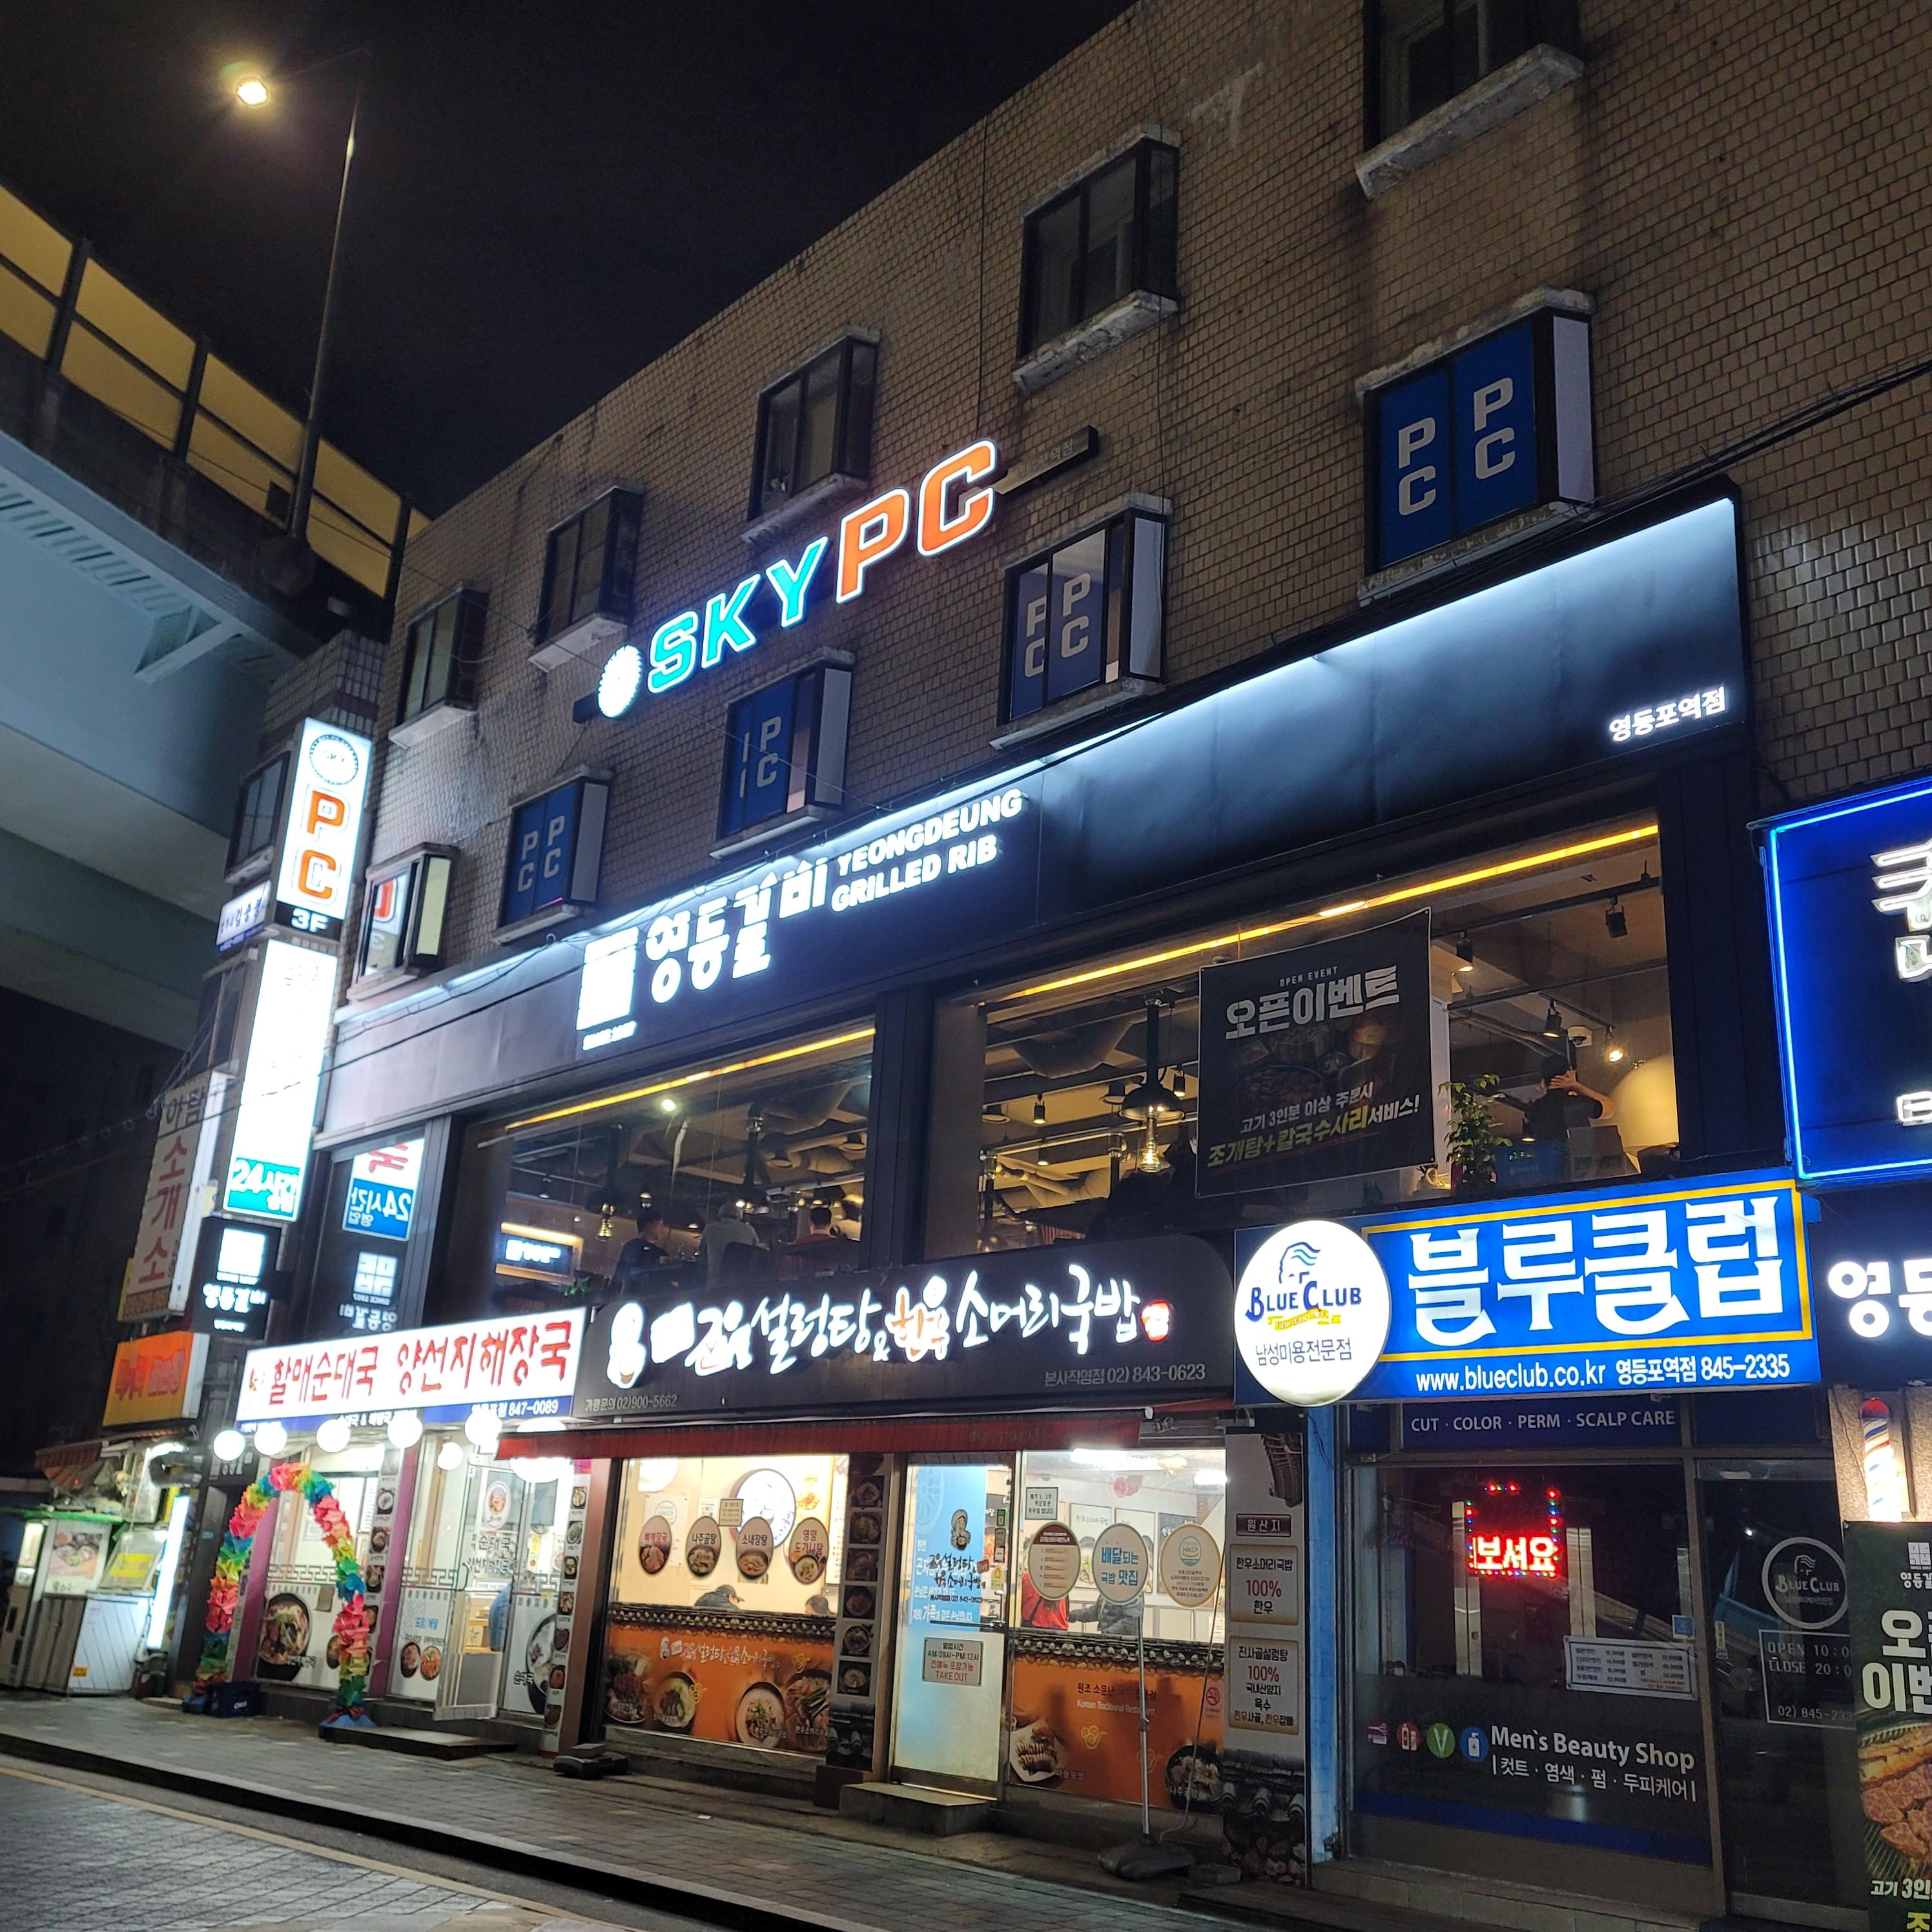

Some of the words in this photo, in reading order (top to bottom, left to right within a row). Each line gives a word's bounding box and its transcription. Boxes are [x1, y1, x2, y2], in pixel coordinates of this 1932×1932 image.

[1474, 377, 1516, 480] PC
[1398, 416, 1436, 516] PC
[1061, 572, 1091, 659] PC
[1608, 684, 1727, 742] 영등포역점
[756, 715, 782, 788] PC
[298, 789, 345, 900] PC
[836, 788, 1023, 877] YEONGDEUNG
[543, 815, 566, 879] PC
[517, 830, 539, 893] PC
[830, 853, 942, 913] GRILLED
[947, 834, 998, 874] RIB
[291, 907, 329, 933] 3F
[645, 856, 828, 1004] 영등갈비
[1279, 974, 1304, 987] OPEN
[1308, 965, 1339, 981] EVENT
[1225, 965, 1400, 1040] 오픈이벤트
[1240, 1115, 1266, 1134] 고기
[1268, 1105, 1300, 1127] 3인분
[1304, 1095, 1332, 1116] 이상
[1335, 1081, 1374, 1109] 주문시
[138, 1135, 188, 1285] 소개소
[1408, 1195, 1784, 1348] 블루클럽
[1244, 1286, 1299, 1322] BLUE
[1302, 1280, 1362, 1311] CLUB
[750, 1287, 882, 1375] 설렁탕
[872, 1330, 891, 1362] &
[955, 1263, 1142, 1355] 소머리국밥
[396, 1319, 572, 1396] 양선지해장국
[1255, 1337, 1352, 1366] 남성미용전문점
[1044, 1370, 1105, 1388] 본사직영점
[1107, 1366, 1129, 1385] 02)
[1132, 1363, 1207, 1382] 843-0623
[1415, 1362, 1607, 1392] www.blueclub.co.kr
[1615, 1355, 1697, 1386] 영등포역점
[1700, 1353, 1791, 1381] 845-2335
[508, 1399, 560, 1417] 847-0089
[1410, 1418, 1439, 1432] CUT
[1452, 1415, 1503, 1431] COLOR
[1517, 1413, 1561, 1430] PERM
[1575, 1412, 1627, 1428] SCALP
[1630, 1410, 1676, 1426] CARE
[692, 1533, 717, 1545] 나주곰탕
[741, 1533, 768, 1547] 소내장탕
[794, 1542, 824, 1558] 도가니탕
[1101, 1547, 1139, 1565] 배달되는
[1236, 1557, 1294, 1572] 한우소머리국밥
[1100, 1571, 1116, 1585] 국밥
[1118, 1570, 1138, 1587] 맛집
[1246, 1579, 1282, 1598] 100%
[1775, 1574, 1809, 1594] BLUE
[1809, 1576, 1840, 1592] CLUB
[1253, 1599, 1273, 1614] 한우
[1880, 1609, 1932, 1660] 오
[1238, 1647, 1289, 1662] 진사골설렁탕
[1767, 1641, 1805, 1656] OPEN
[1248, 1665, 1280, 1683] 100%
[1769, 1660, 1807, 1674] CLOSE
[1076, 1682, 1091, 1694] 원조
[1093, 1683, 1115, 1697] 소문난
[1246, 1683, 1282, 1696] 국내산양지
[1076, 1699, 1096, 1709] Korean
[1255, 1698, 1271, 1711] 육수
[1801, 1707, 1855, 1721] 845-233
[1553, 1732, 1630, 1767] Beauty
[1634, 1742, 1695, 1774] Shop
[1499, 1757, 1530, 1776] 컷트
[1544, 1762, 1575, 1785] 염색
[1590, 1768, 1607, 1789] 펌
[1623, 1773, 1688, 1801] 두피케어
[1870, 1880, 1899, 1896] 고기
[1901, 1877, 1932, 1900] 3인
